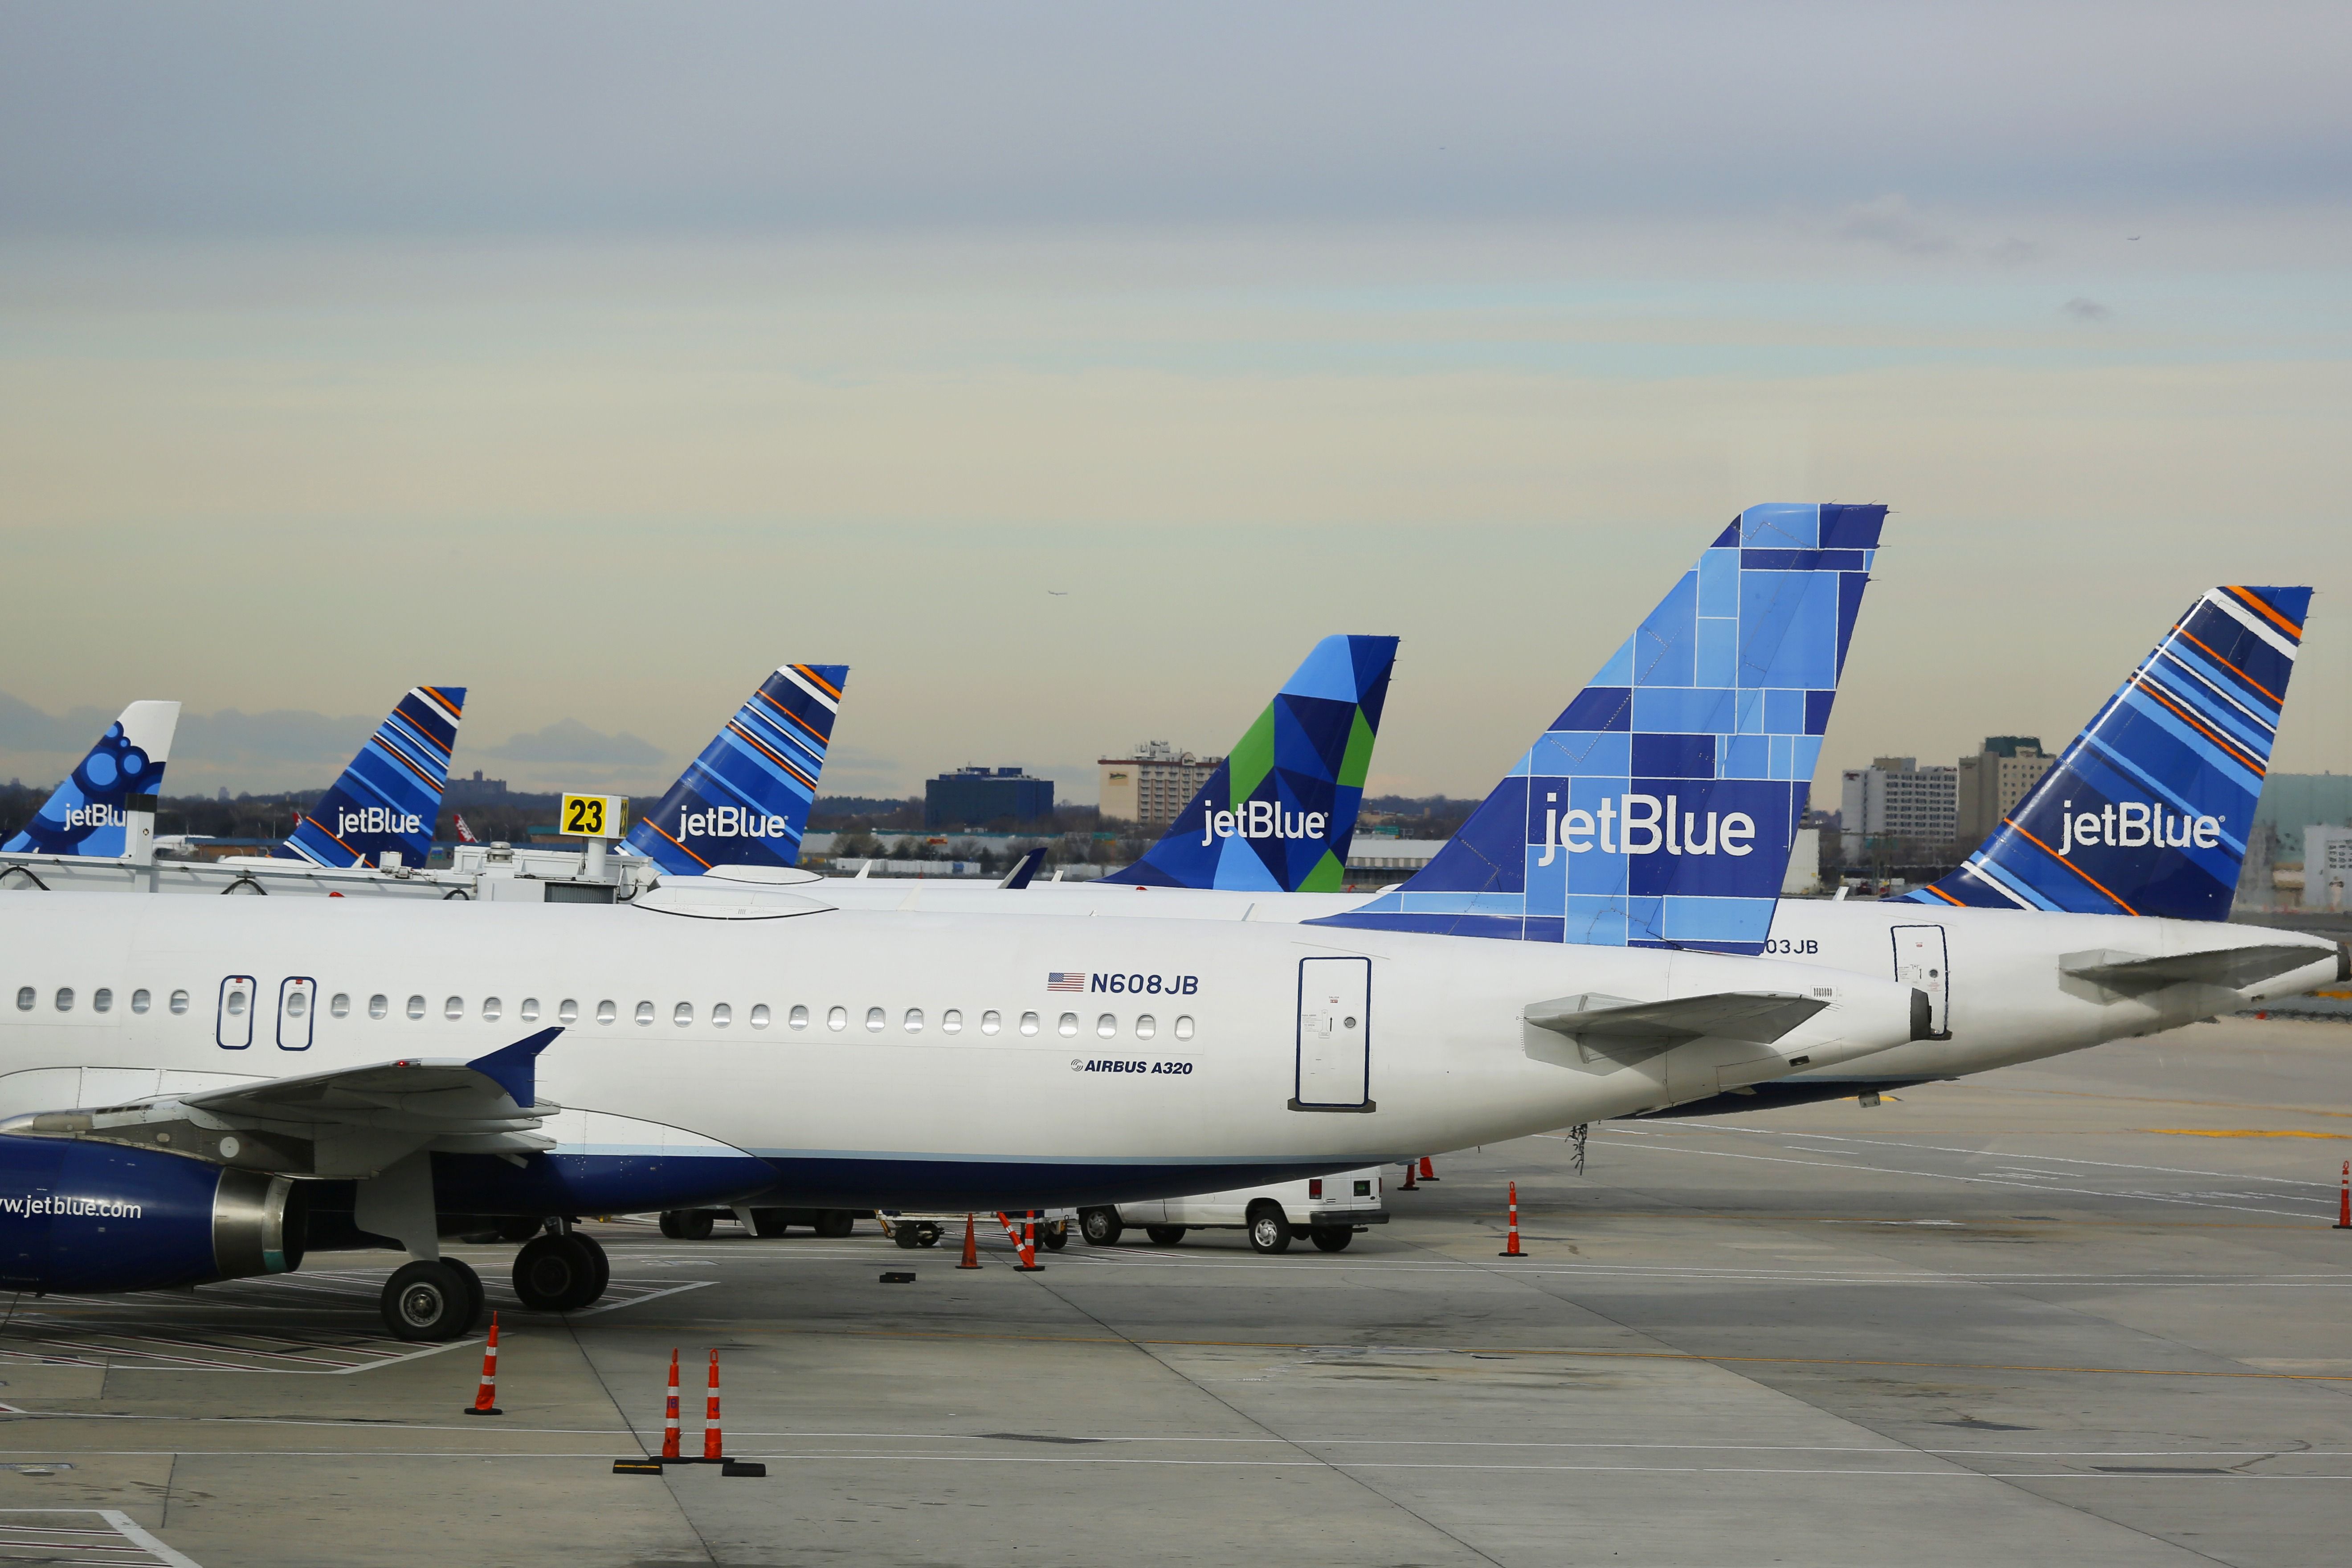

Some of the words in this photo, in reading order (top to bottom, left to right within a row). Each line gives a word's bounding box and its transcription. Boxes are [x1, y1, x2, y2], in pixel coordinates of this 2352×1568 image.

[63, 803, 126, 831] jetBlu
[336, 806, 420, 838] jetBlue
[568, 799, 602, 833] 23
[677, 805, 785, 843] jetBlue
[1201, 800, 1325, 847] jetBlue
[1538, 792, 1756, 867] jetBlue
[2058, 800, 2221, 856] jetBlue
[1766, 939, 1818, 954] 03JB
[1091, 973, 1198, 995] N608JB
[1085, 1060, 1147, 1073] AIRBUS
[1151, 1062, 1193, 1074] A320
